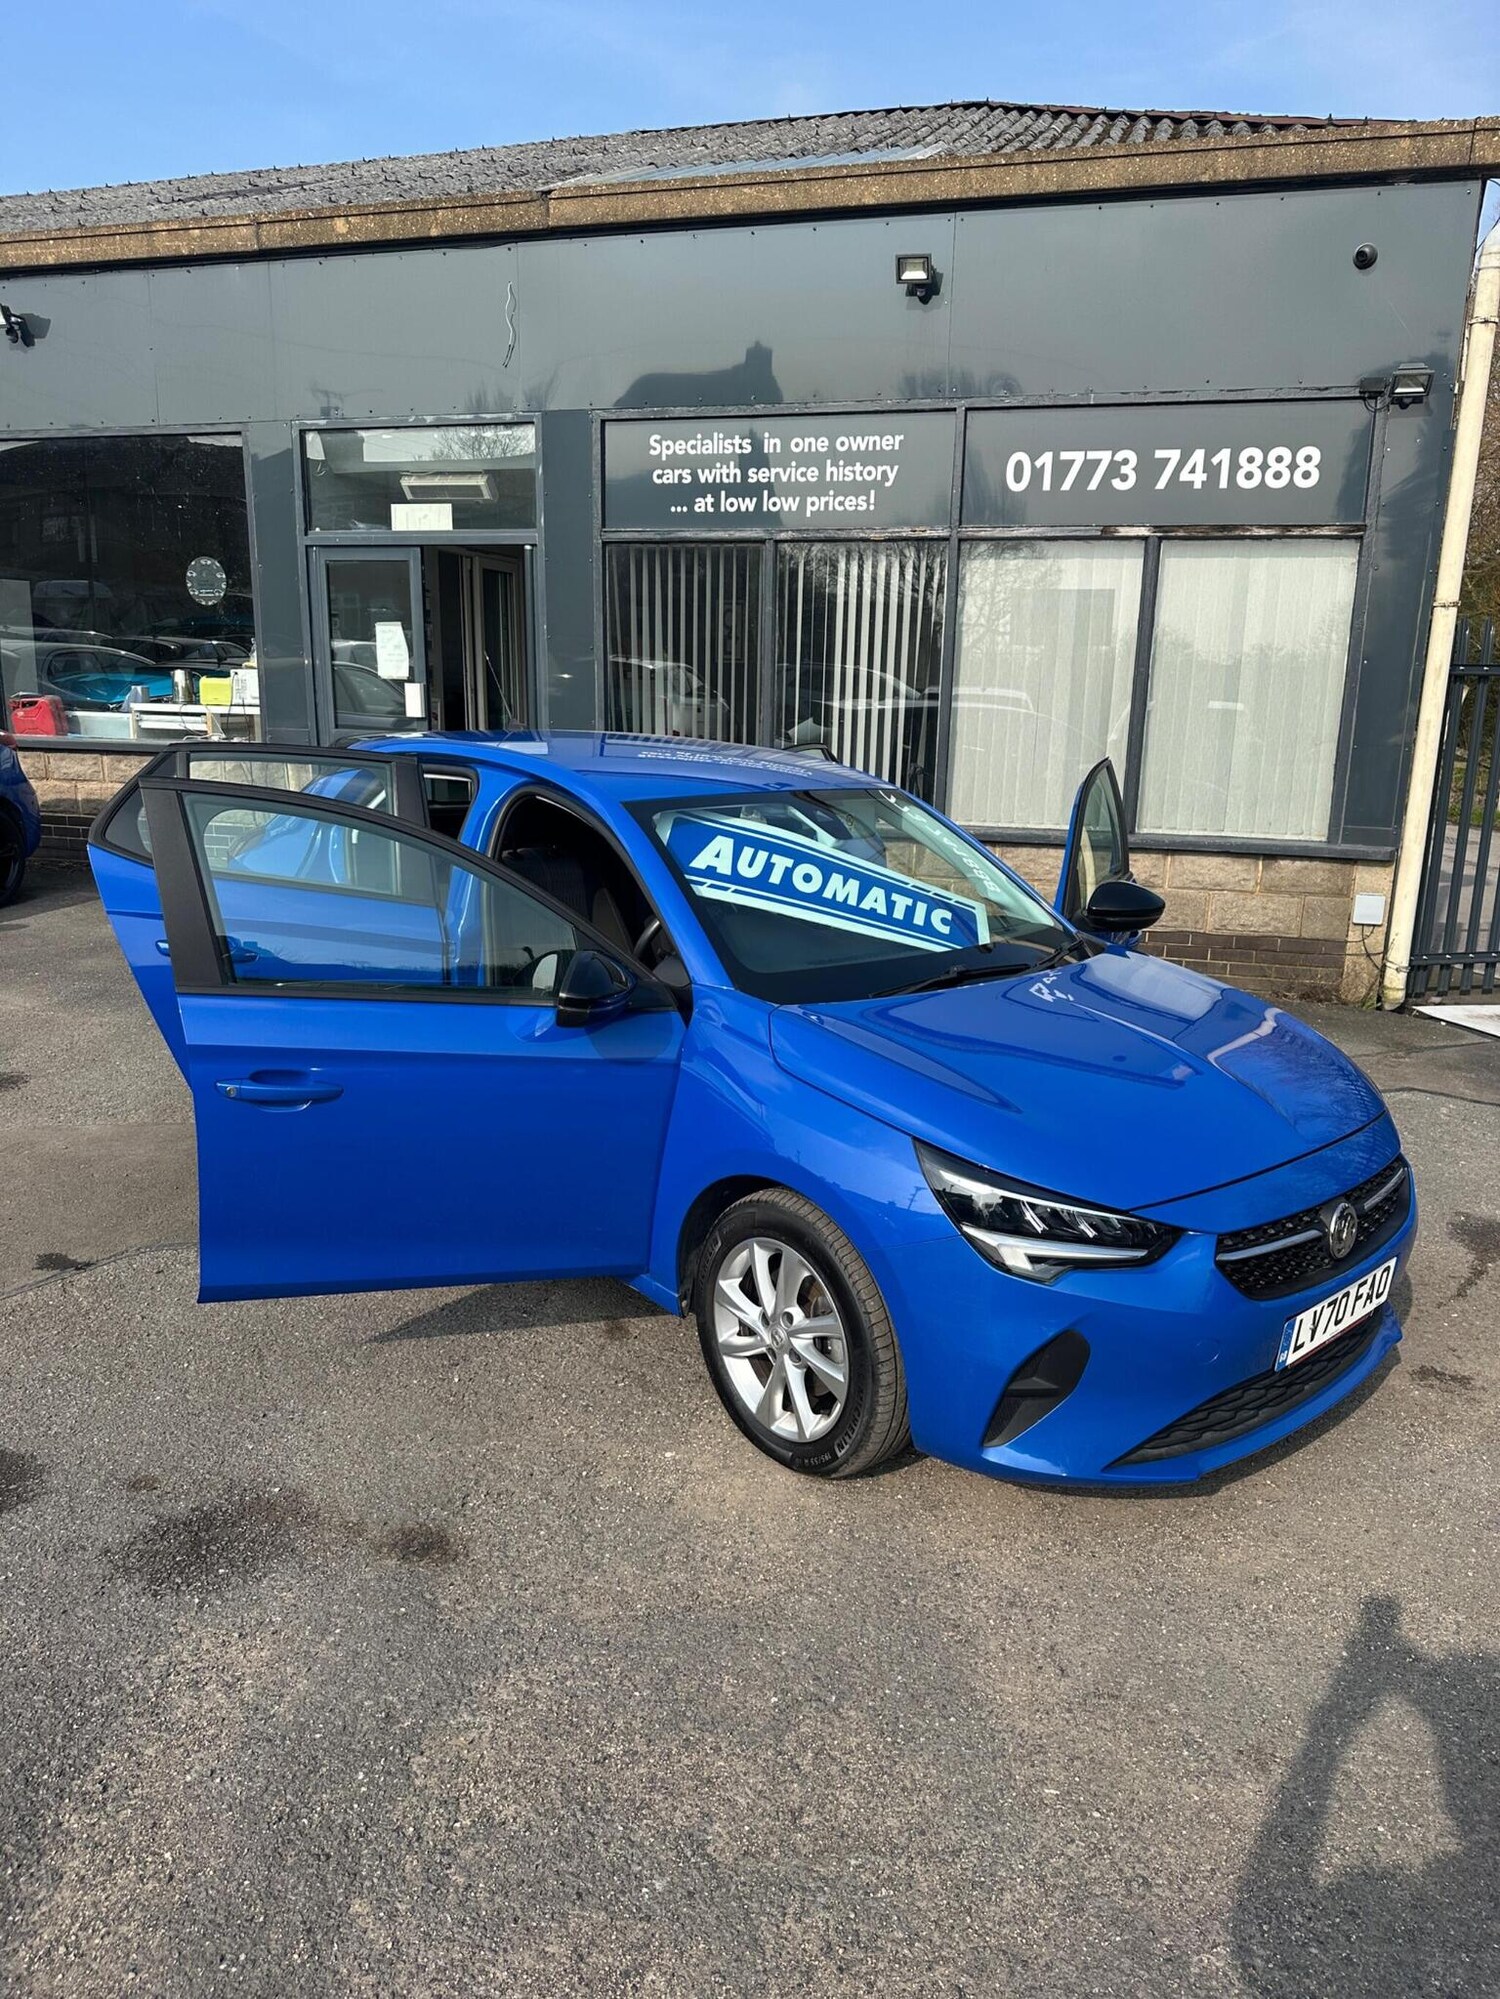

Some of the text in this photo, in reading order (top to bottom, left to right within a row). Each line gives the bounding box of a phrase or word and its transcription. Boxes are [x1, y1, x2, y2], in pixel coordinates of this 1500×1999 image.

[649, 431, 905, 461] Specialists in one owner
[652, 458, 899, 487] cars with service history
[1005, 445, 1322, 492] 01773 741888
[693, 493, 715, 513] at
[720, 490, 758, 513] low
[762, 489, 802, 512] low
[805, 489, 876, 518] prices!
[688, 834, 953, 936] AUTOMATIC
[1292, 1264, 1393, 1354] LV70 FAO
